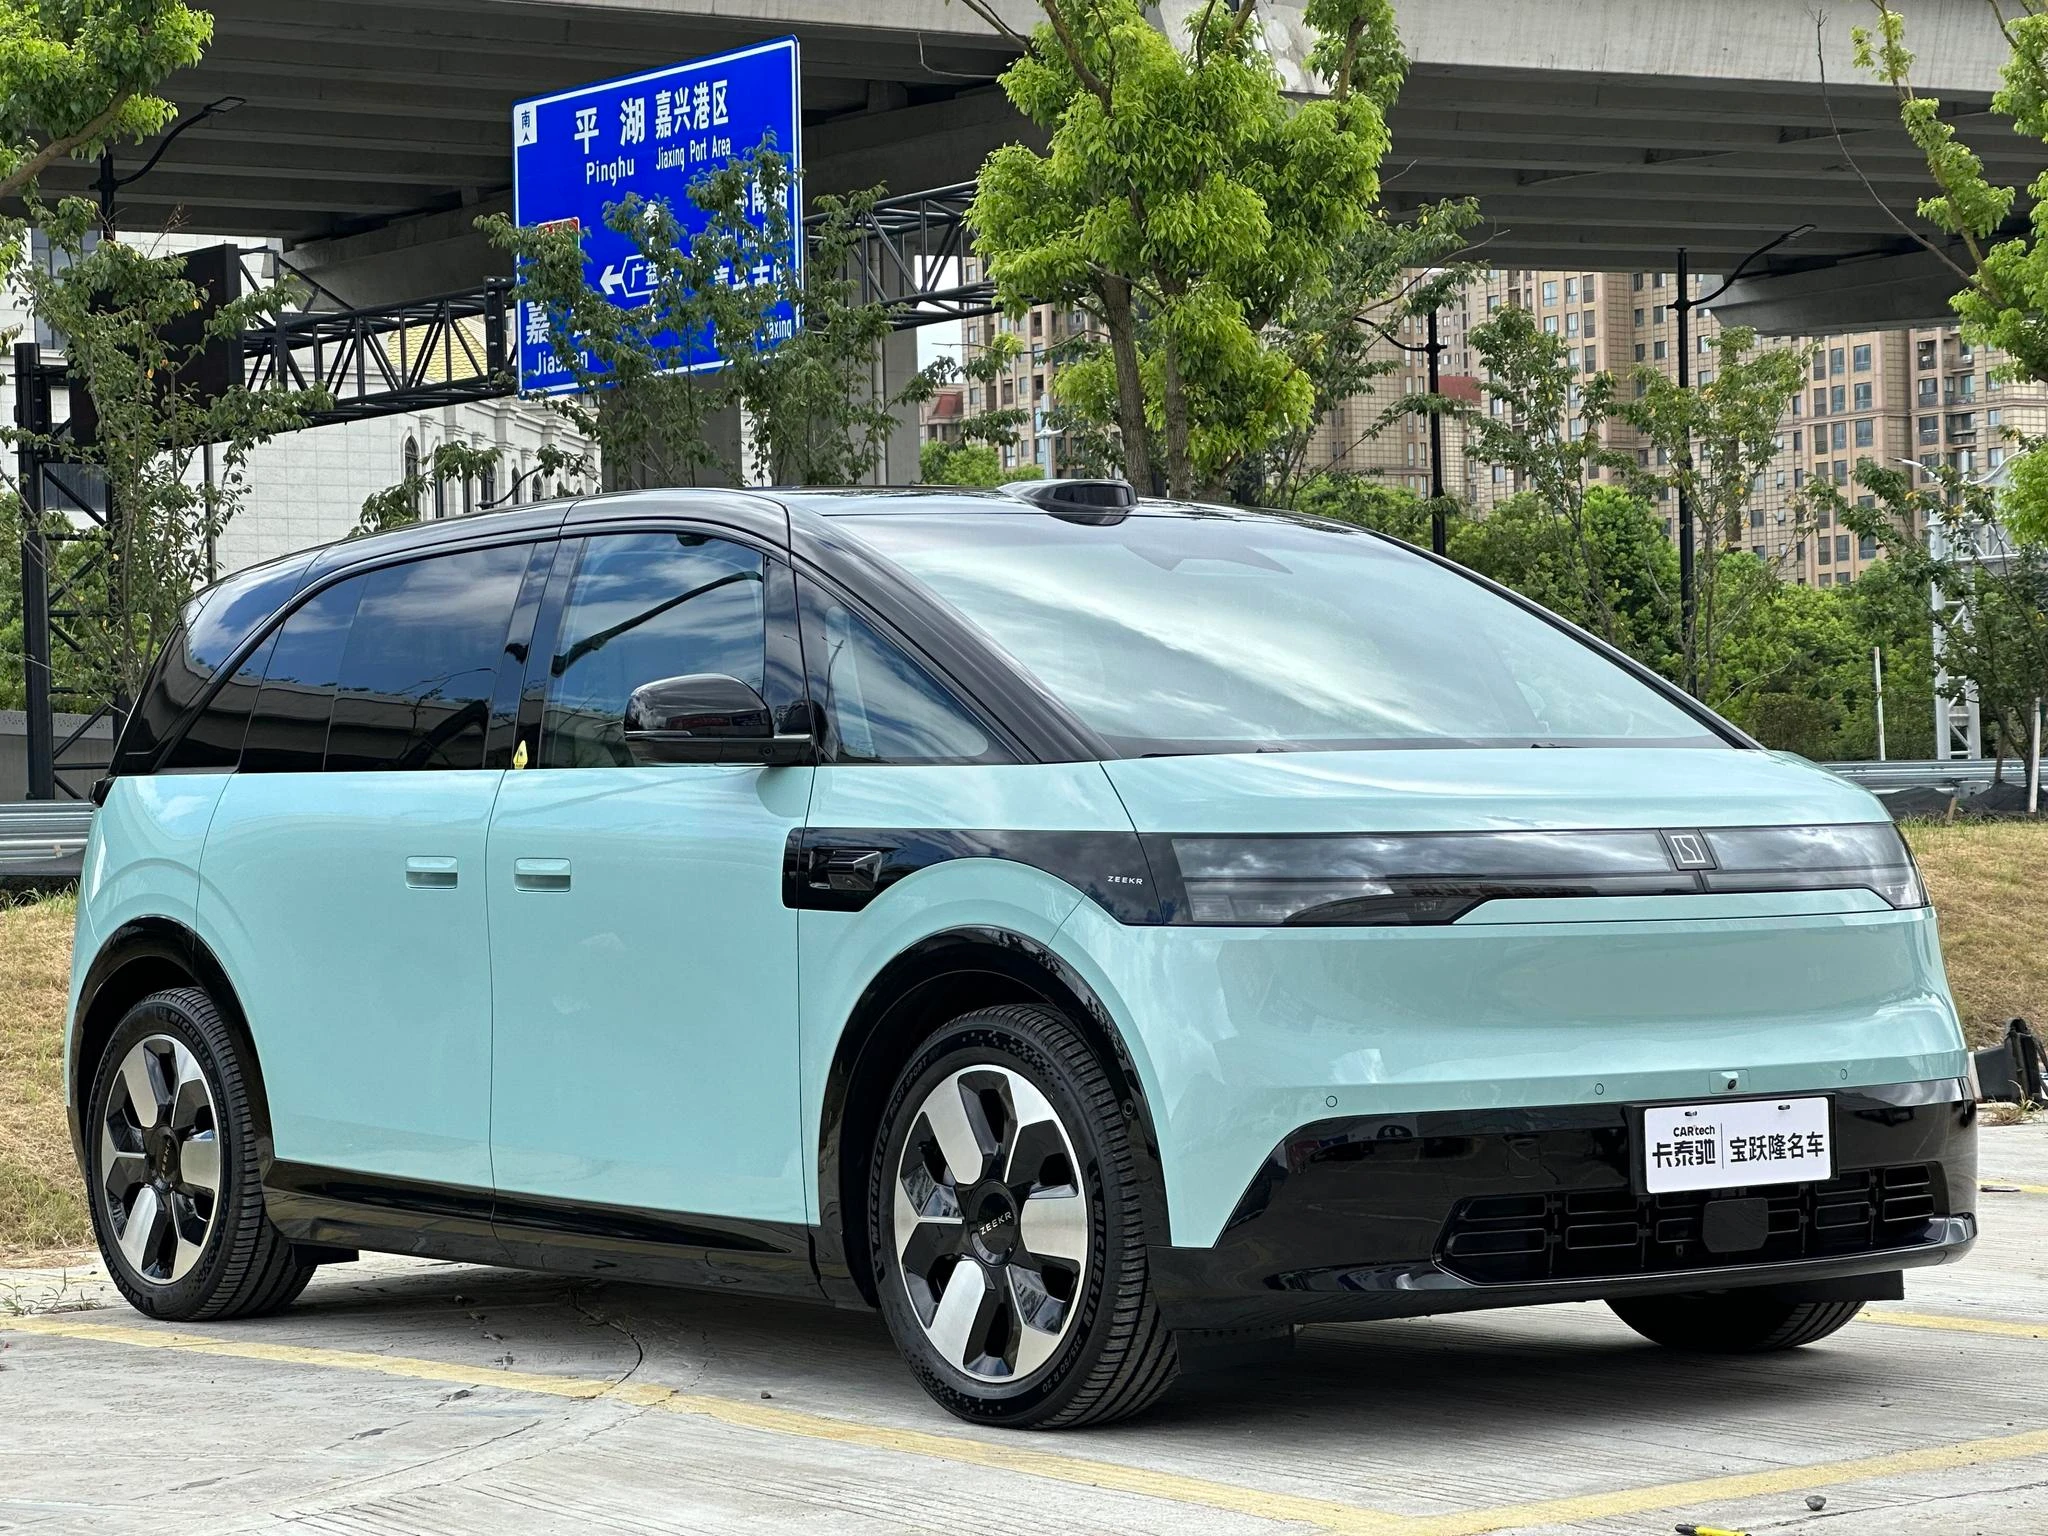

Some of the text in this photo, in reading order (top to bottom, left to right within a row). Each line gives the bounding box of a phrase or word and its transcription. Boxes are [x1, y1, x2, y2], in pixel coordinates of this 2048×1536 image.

[521, 110, 531, 128] 南
[655, 79, 729, 139] 嘉兴港区
[574, 98, 645, 154] 平湖
[656, 136, 731, 172] Jiaxing Port Area
[586, 156, 635, 187] Pinghu
[1107, 875, 1143, 885] ZEEKR
[1652, 1138, 1716, 1169] 卡泰驰
[1729, 1131, 1825, 1163] 宝跃隆名车
[980, 1211, 1012, 1235] ZEEKR
[1083, 1199, 1106, 1327] MICHELIN
